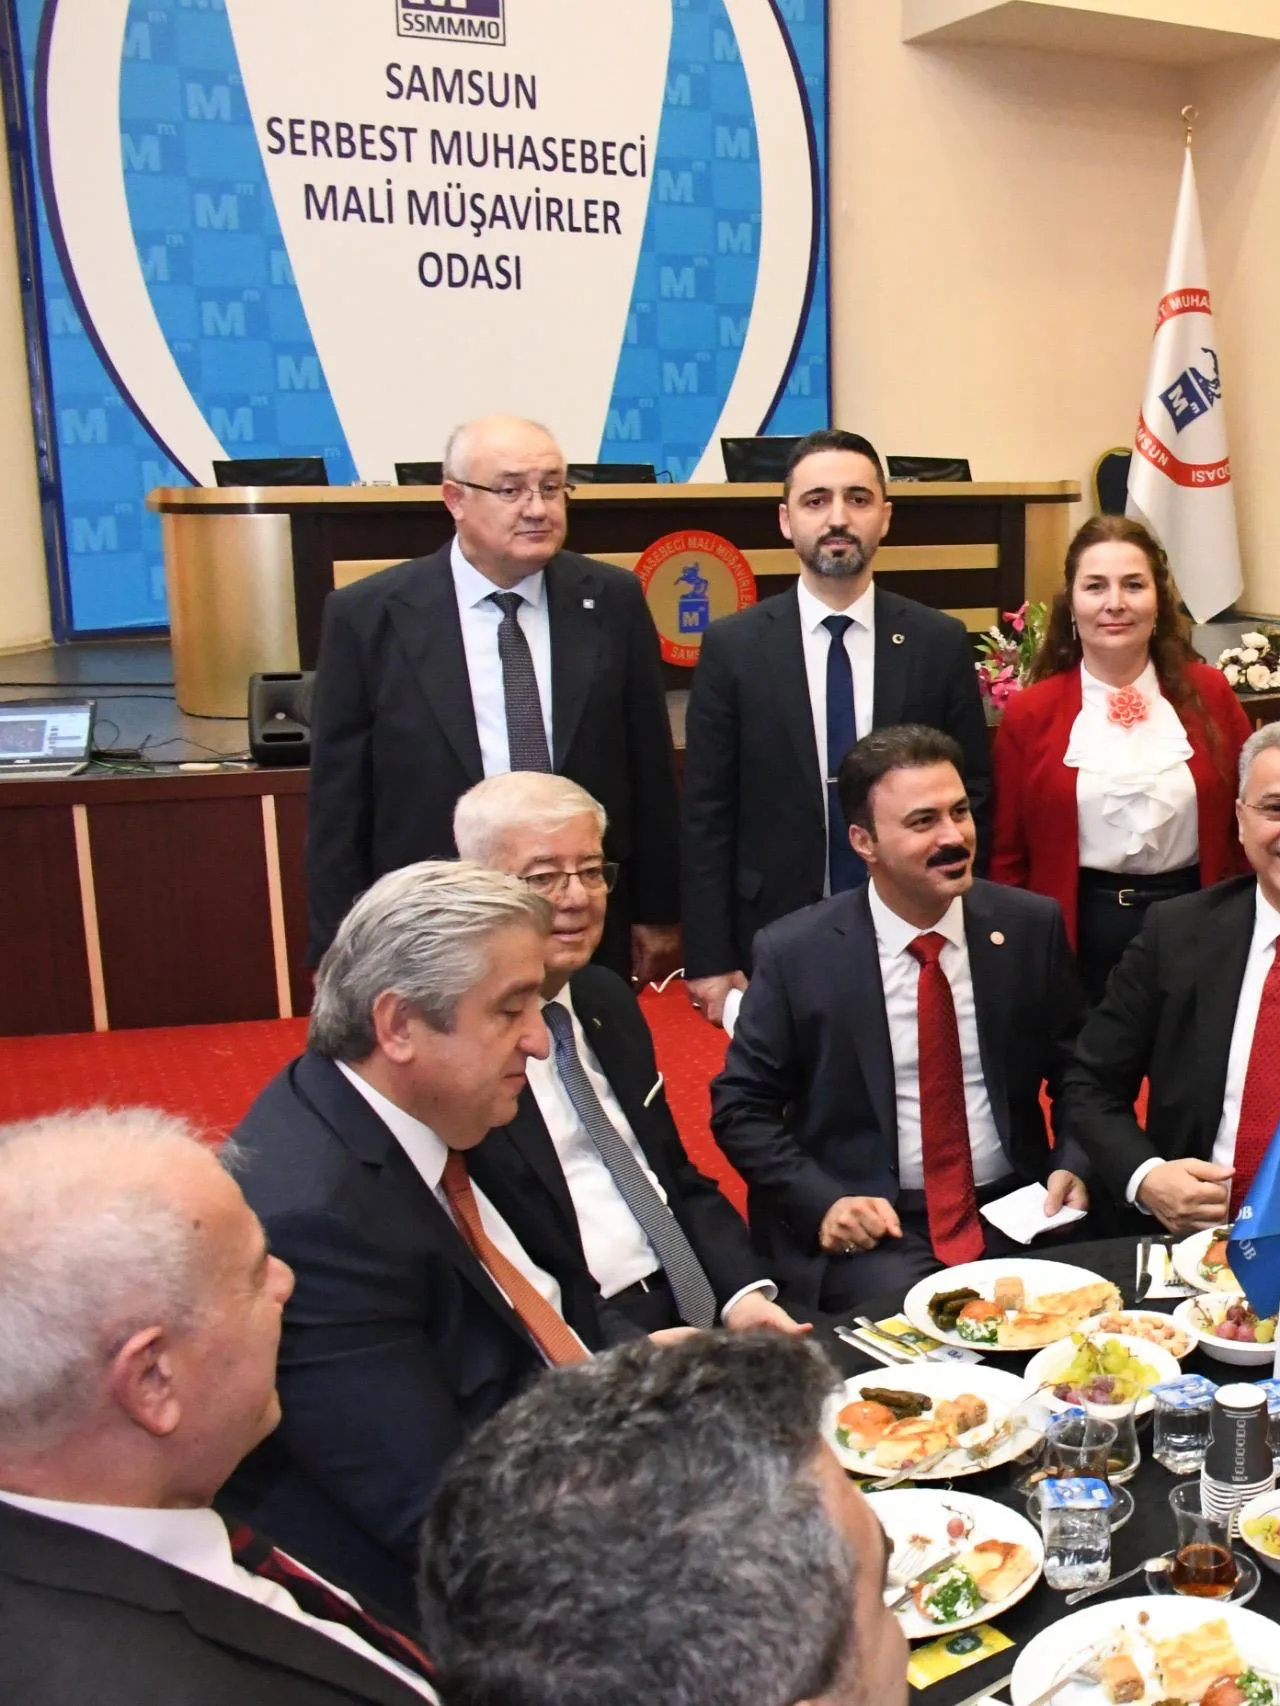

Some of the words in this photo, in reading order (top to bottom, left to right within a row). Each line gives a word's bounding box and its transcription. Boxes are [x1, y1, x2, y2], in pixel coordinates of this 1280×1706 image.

[402, 13, 500, 40] SSMMMO
[385, 62, 538, 110] SAMSUN
[266, 116, 418, 164] SERBEST
[430, 134, 647, 178] MUHASEBECİ
[304, 177, 394, 224] MALİ
[407, 182, 622, 238] MÜŞAVİRLER
[418, 251, 521, 290] ODASI
[1169, 295, 1209, 311] MUHA
[671, 646, 700, 661] SAMS
